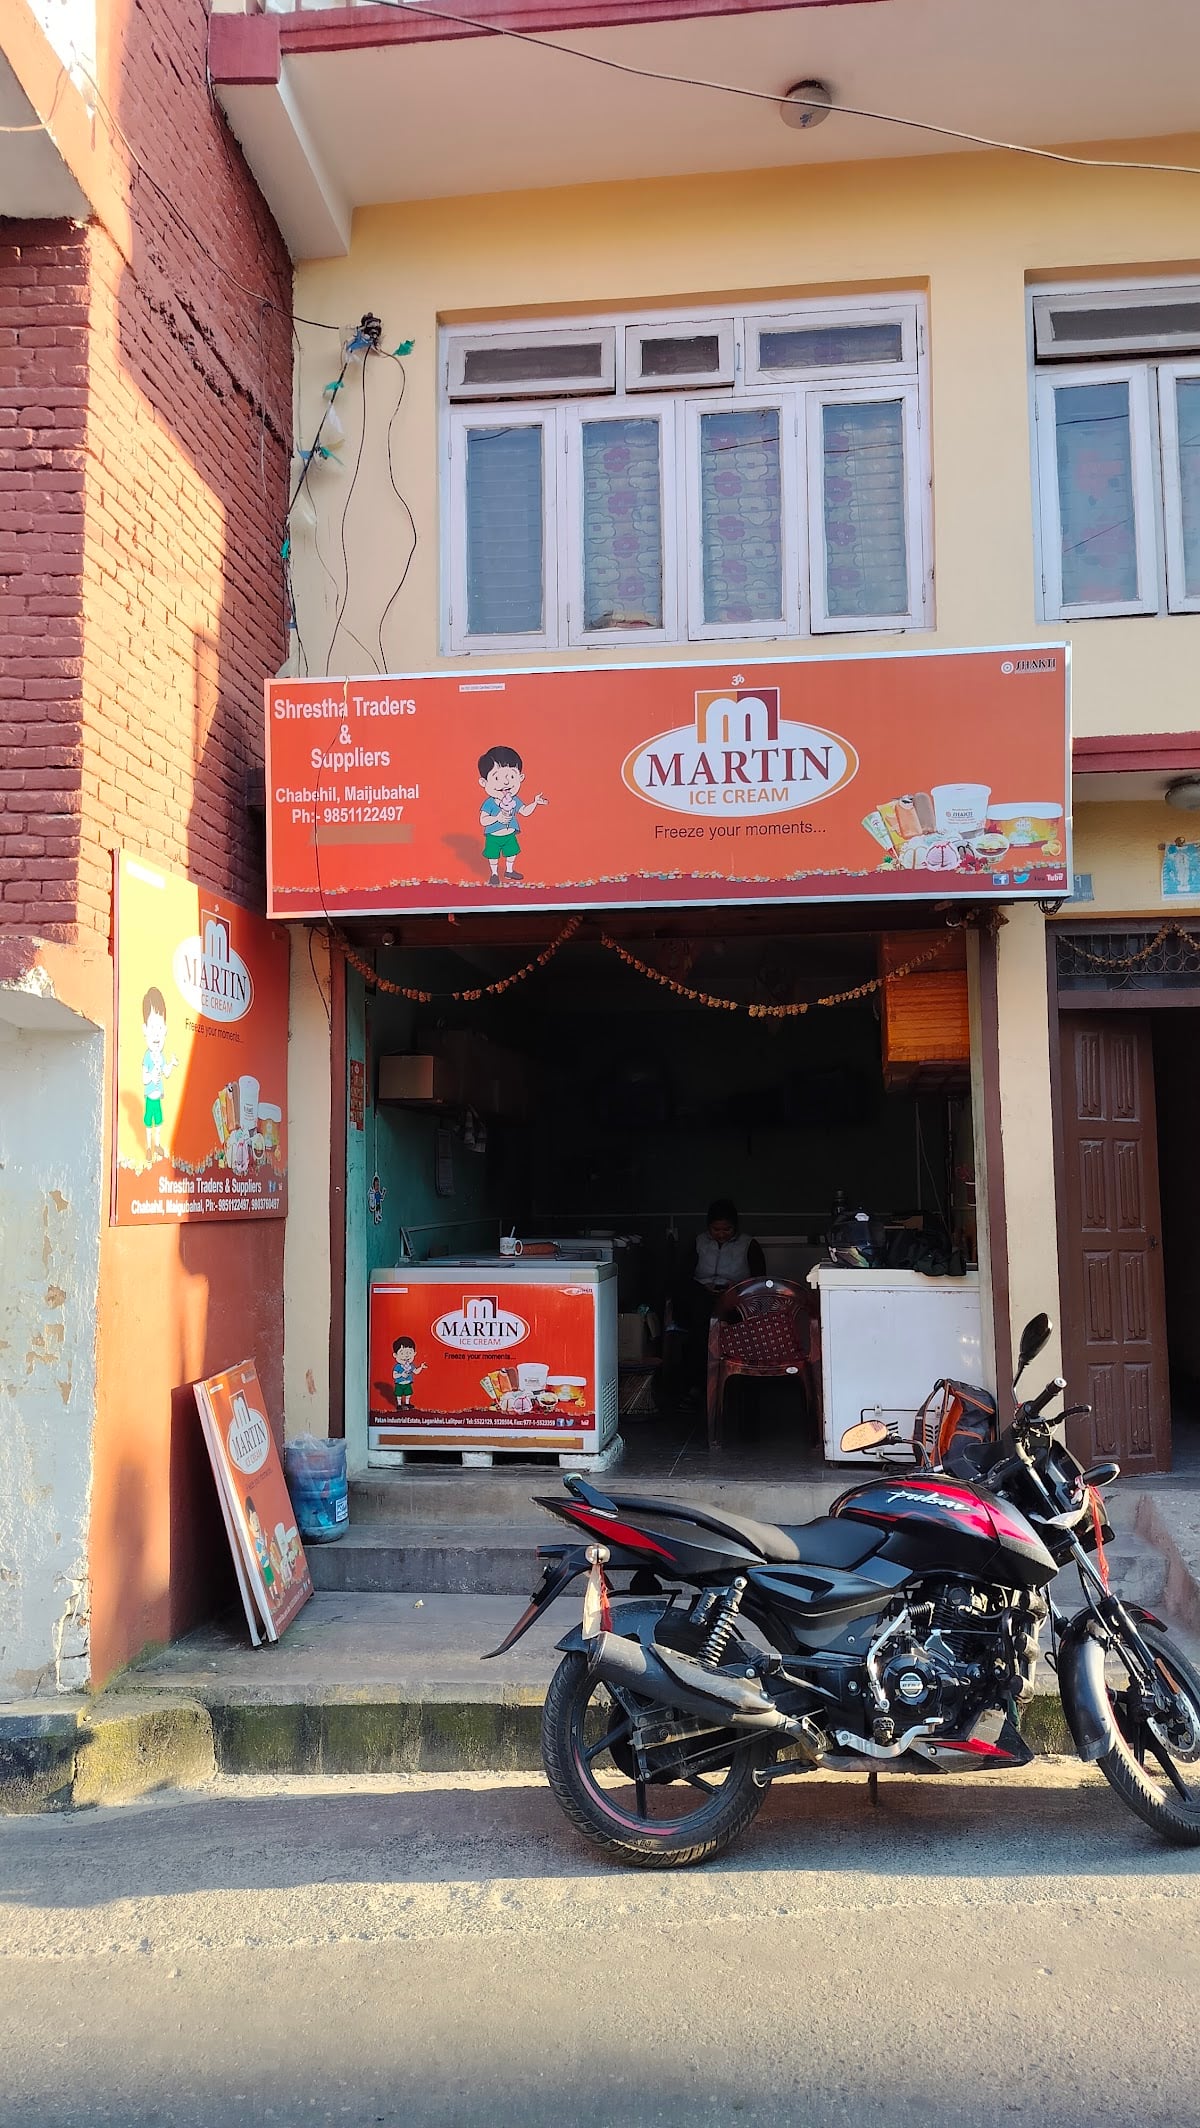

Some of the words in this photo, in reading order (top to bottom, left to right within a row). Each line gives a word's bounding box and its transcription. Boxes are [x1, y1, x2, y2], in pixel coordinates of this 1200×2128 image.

[274, 698, 348, 719] Shrestha
[352, 696, 416, 717] Traders
[339, 724, 352, 745] &
[311, 747, 390, 772] Suppliers
[645, 746, 833, 787] MARTIN
[275, 787, 341, 804] Chabehil,
[344, 784, 419, 804] Maijubahal
[689, 790, 717, 805] ICE
[722, 787, 789, 804] CREAM
[292, 808, 321, 824] Ph:-
[323, 806, 404, 823] 9851122497
[655, 825, 704, 839] Freeze
[709, 825, 741, 840] your
[745, 820, 826, 836] moments...
[184, 955, 247, 1002] MARTIN
[210, 996, 233, 1014] CREAM
[185, 1018, 204, 1034] Freeze
[204, 1025, 217, 1038] your
[158, 1177, 194, 1194] Shrestha
[196, 1178, 223, 1193] Traders
[225, 1179, 231, 1192] &
[232, 1179, 261, 1196] Suppliers
[441, 1321, 518, 1337] MARTIN
[459, 1338, 471, 1346] ICE
[473, 1338, 501, 1346] CREAM
[444, 1352, 466, 1360] Freeze
[467, 1353, 481, 1361] your
[232, 1420, 266, 1461] MARTIN
